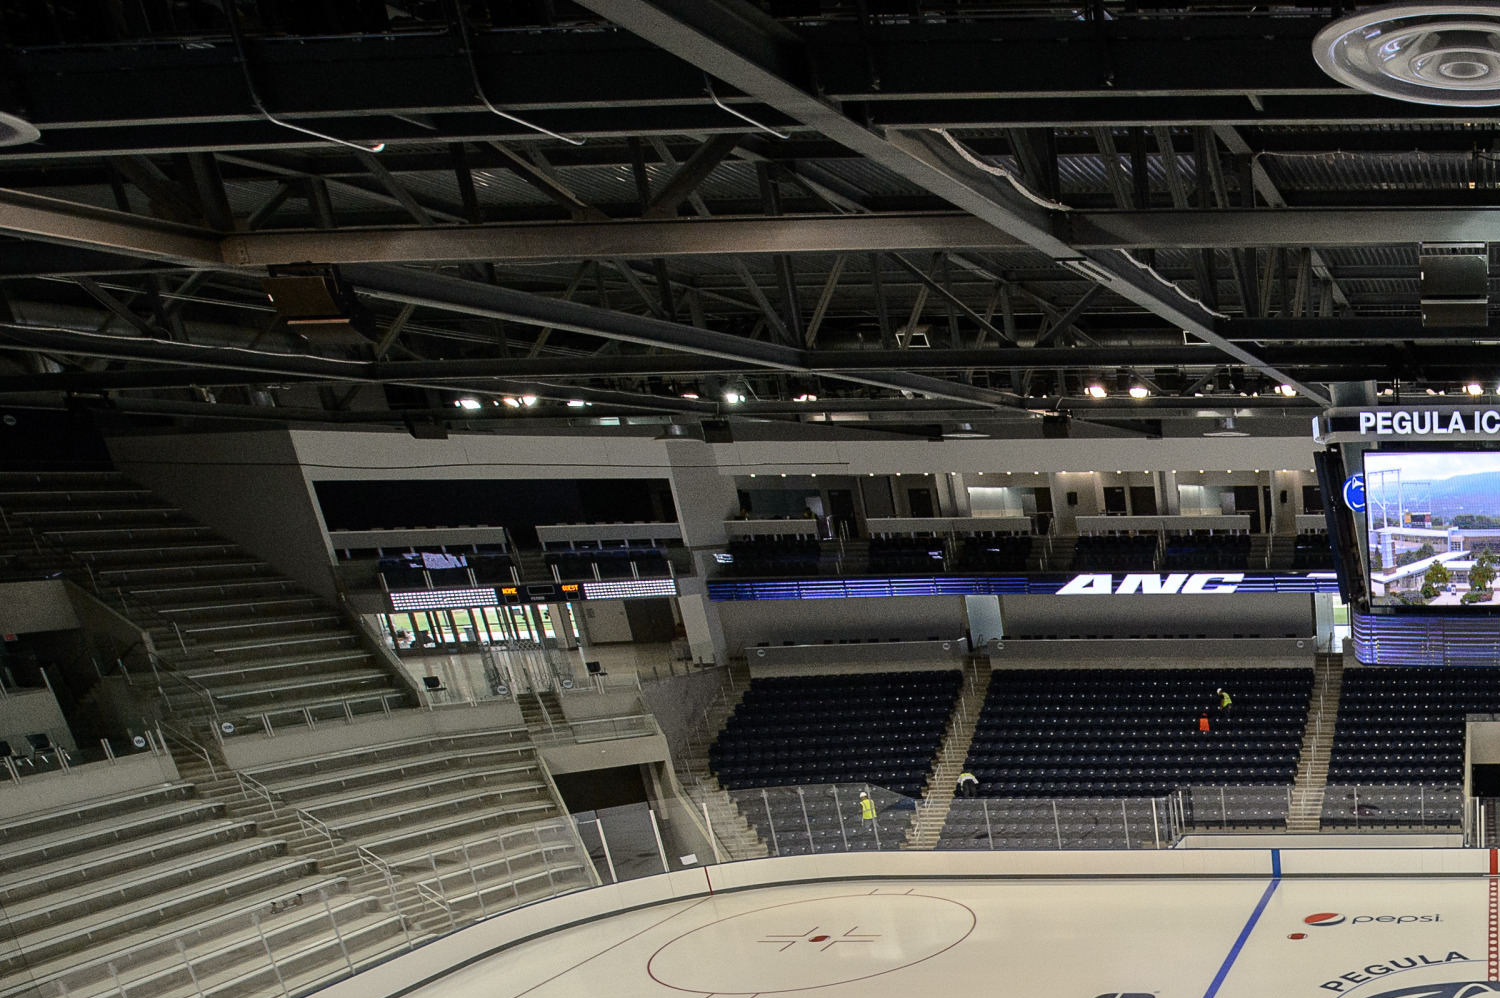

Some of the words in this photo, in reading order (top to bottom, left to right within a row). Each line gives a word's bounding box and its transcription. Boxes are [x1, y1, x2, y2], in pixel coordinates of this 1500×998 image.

[1359, 411, 1466, 434] PEGULA
[1055, 573, 1245, 594] ANC
[1352, 914, 1440, 924] pepsi
[1319, 951, 1470, 992] PEGULA
